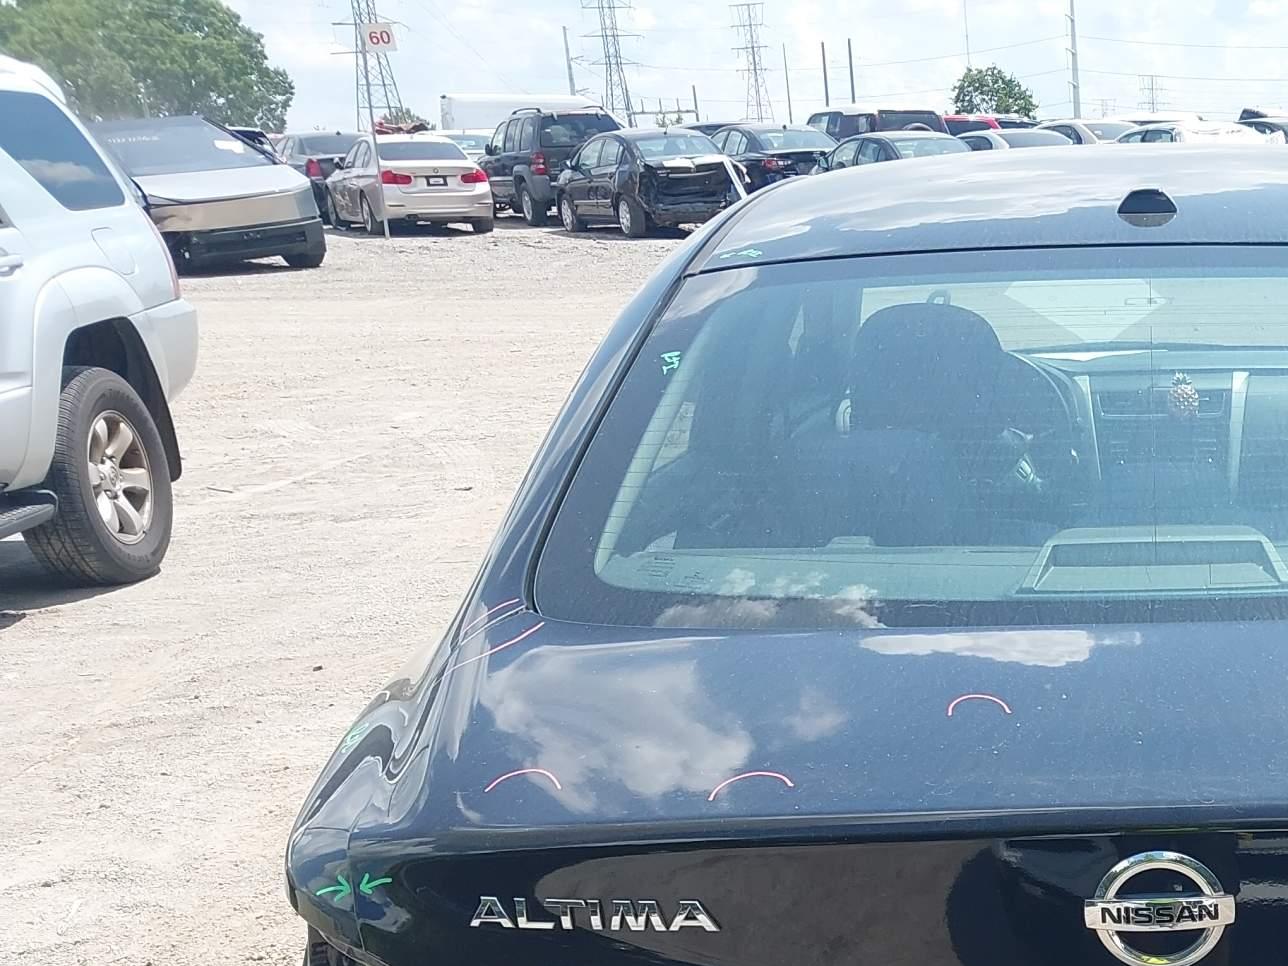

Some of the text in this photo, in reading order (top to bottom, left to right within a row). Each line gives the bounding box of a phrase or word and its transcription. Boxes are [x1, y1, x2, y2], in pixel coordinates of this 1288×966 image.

[369, 30, 391, 45] 60
[469, 896, 721, 932] ALTIMA
[1101, 903, 1220, 925] NISSAN
